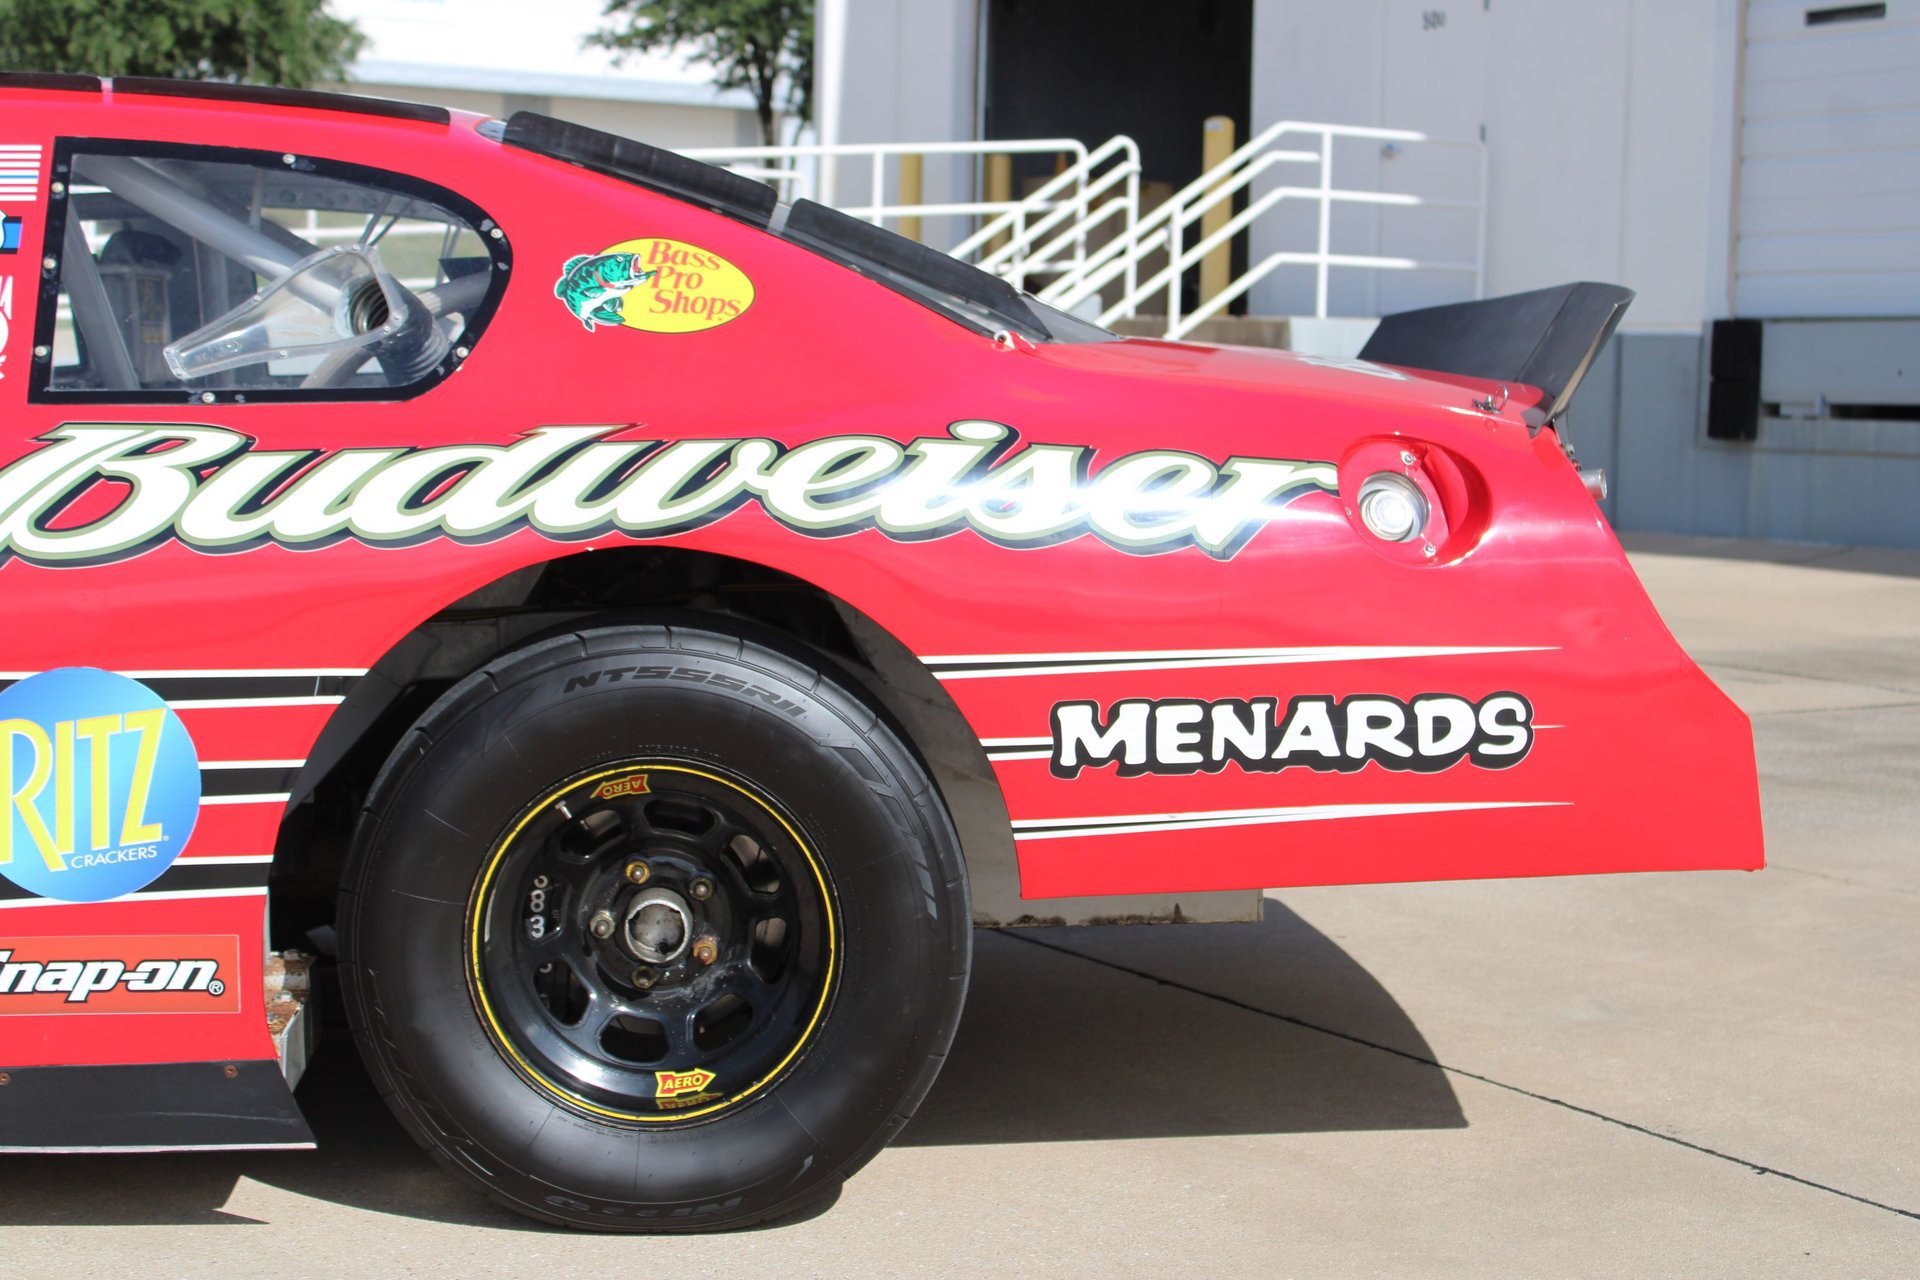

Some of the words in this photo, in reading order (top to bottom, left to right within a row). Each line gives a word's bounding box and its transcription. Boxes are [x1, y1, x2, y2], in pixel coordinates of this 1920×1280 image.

[647, 240, 721, 270] Bass
[650, 265, 703, 290] Pro
[648, 289, 742, 321] Shops
[0, 419, 1338, 562] Budweiser
[1050, 692, 1533, 778] MENARDS
[0, 707, 167, 872] RITZ
[602, 778, 642, 796] AERO
[70, 845, 158, 870] CRACKERS
[662, 1074, 704, 1091] AERO
